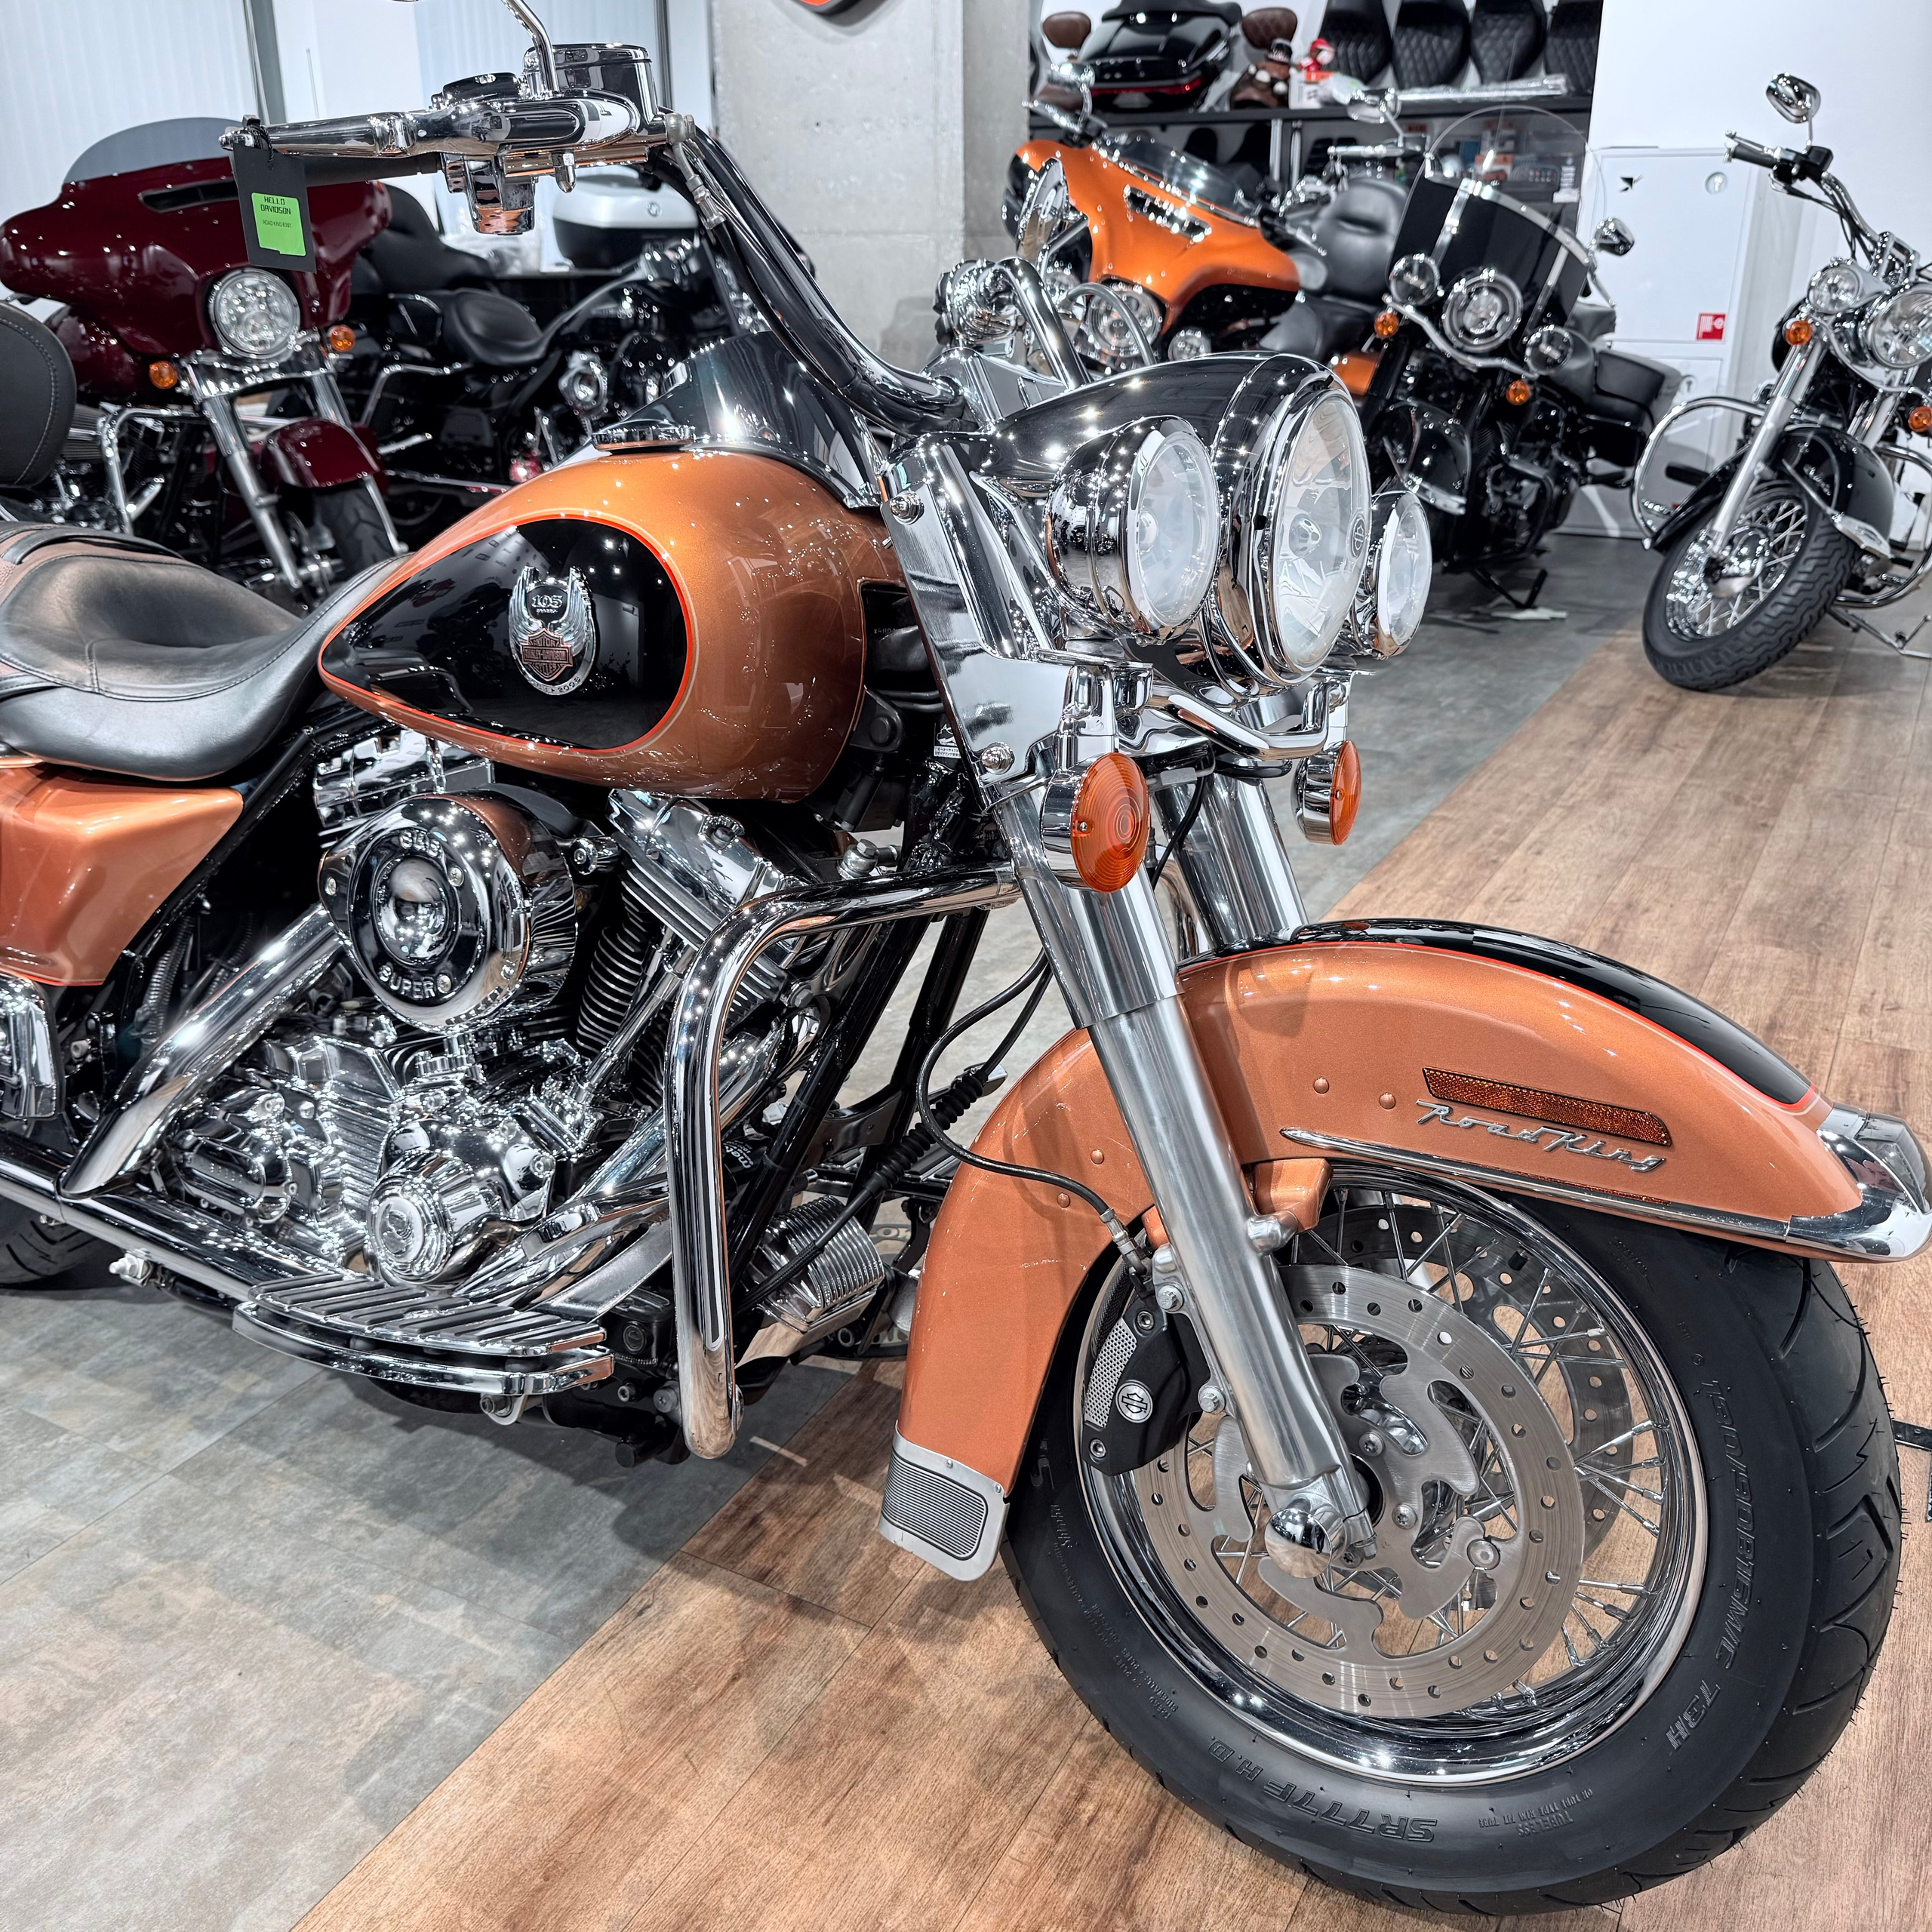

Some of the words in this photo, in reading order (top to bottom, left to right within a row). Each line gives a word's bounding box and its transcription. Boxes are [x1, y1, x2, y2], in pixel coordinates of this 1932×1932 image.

[263, 195, 285, 205] HELLO
[260, 204, 291, 215] DAVIDSON
[531, 594, 563, 608] 105
[533, 636, 556, 647] MOTOR
[525, 648, 567, 661] HARLEY-DAVIDSON
[534, 663, 557, 675] CYCLES
[378, 964, 436, 999] SUPER
[1415, 1099, 1540, 1143] Road
[1540, 1126, 1666, 1173] King
[1666, 1679, 1721, 1752] 73H
[1208, 1735, 1264, 1782] H.D.
[1263, 1777, 1438, 1844] SR777F
[1518, 1809, 1536, 1822] RIM
[1478, 1818, 1500, 1829] TUBE
[1516, 1810, 1574, 1838] TUBELESS
